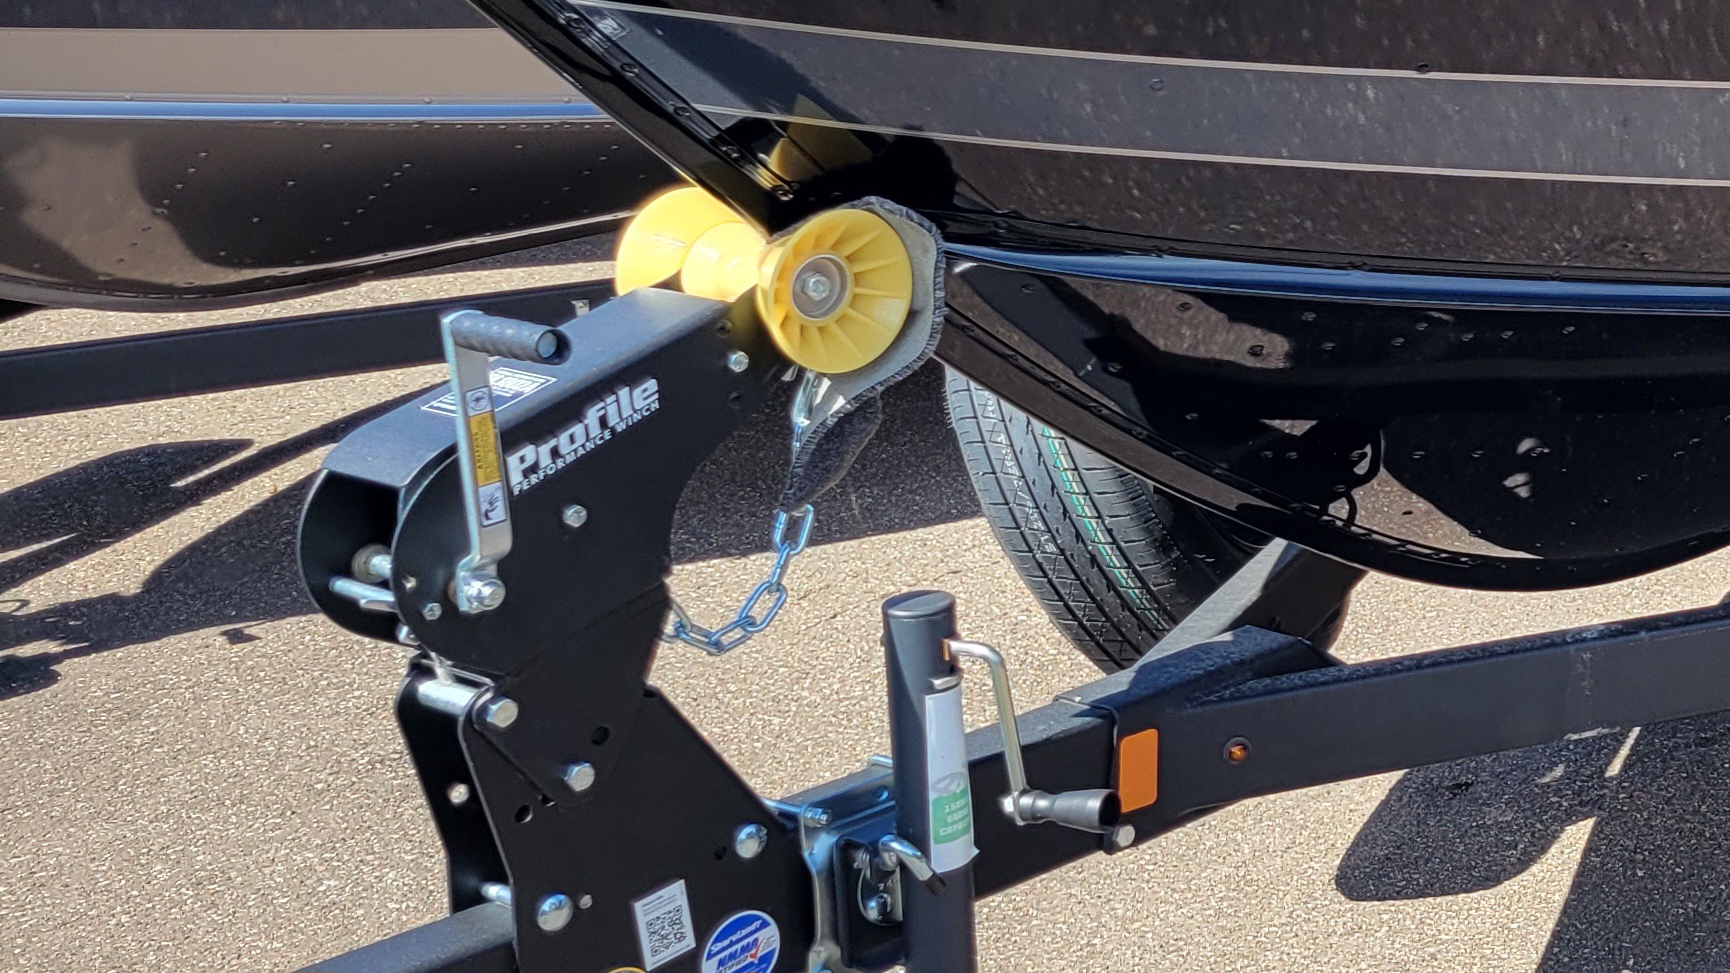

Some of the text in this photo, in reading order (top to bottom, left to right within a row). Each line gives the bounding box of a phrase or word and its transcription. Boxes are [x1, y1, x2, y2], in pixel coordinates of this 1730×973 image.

[505, 378, 660, 487] Profile
[512, 428, 613, 496] PERFORMANCE
[614, 399, 660, 433] WINCH
